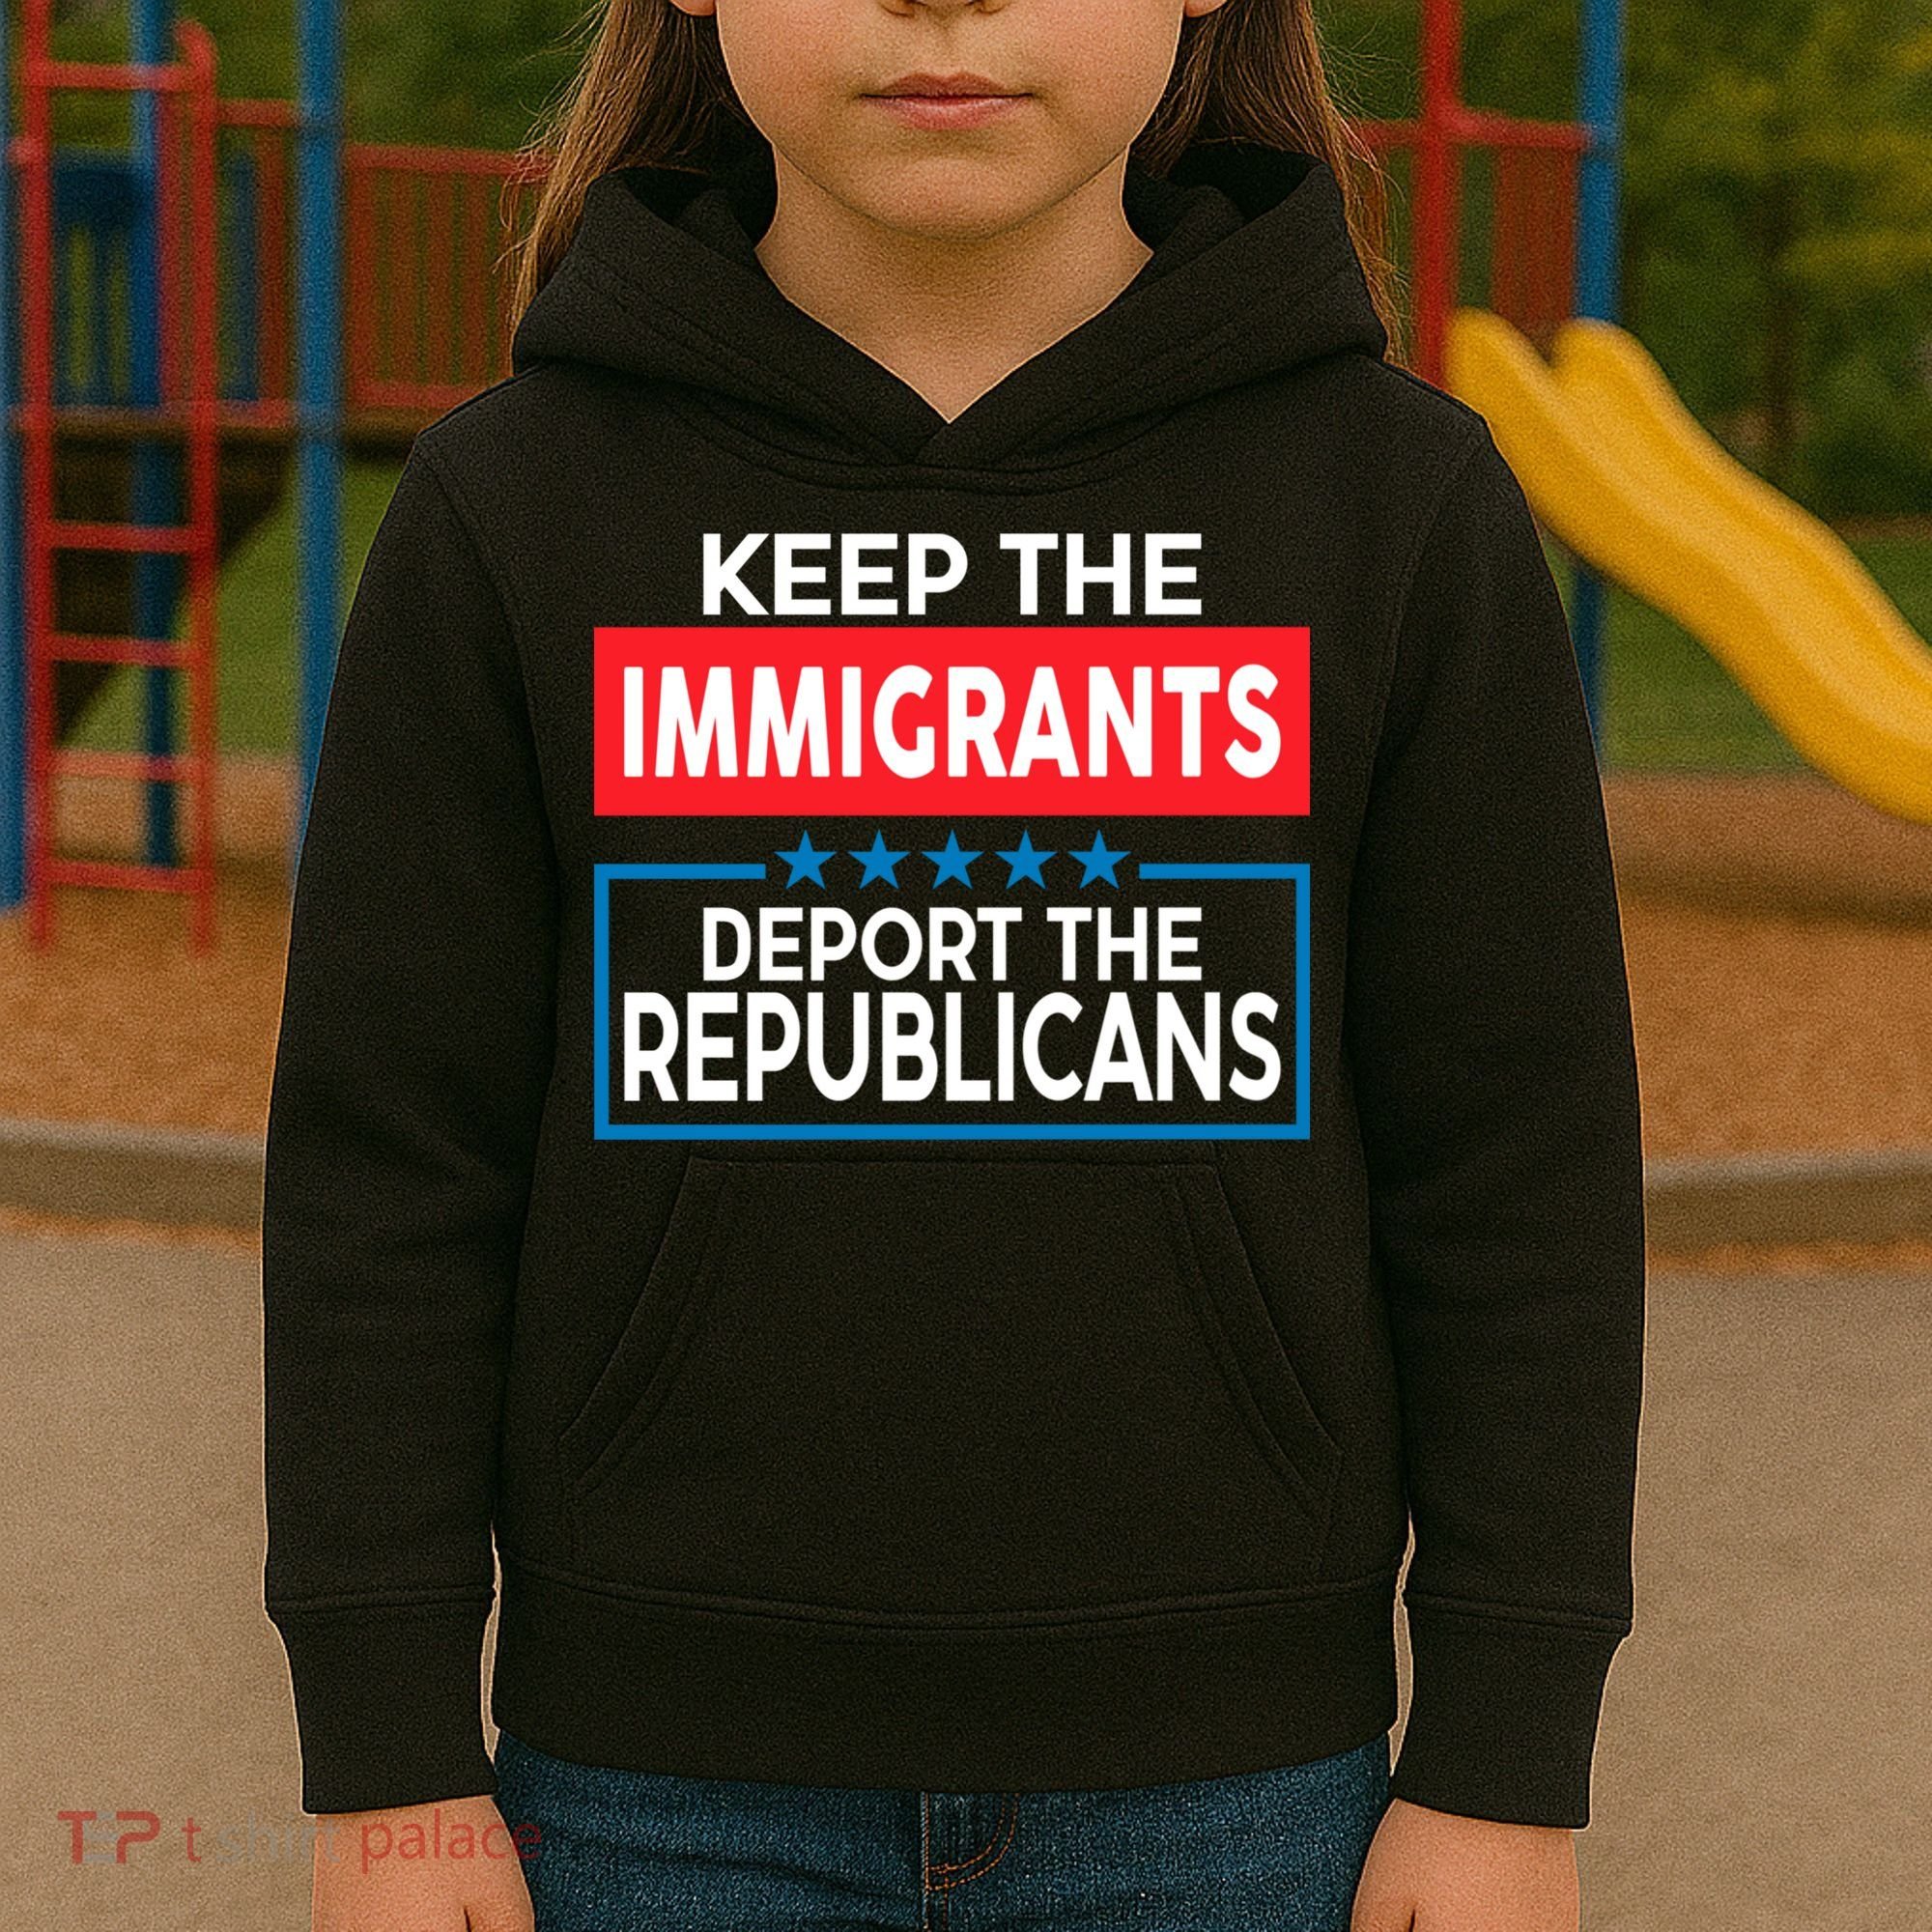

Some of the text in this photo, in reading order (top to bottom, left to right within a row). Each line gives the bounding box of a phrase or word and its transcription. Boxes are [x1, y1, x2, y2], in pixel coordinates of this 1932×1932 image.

[703, 533, 1201, 614] KEEP THE
[624, 665, 1280, 779] IMMIGRANTS
[703, 907, 1202, 981] DEPORT THE
[624, 991, 1281, 1101] REPUBLICANS
